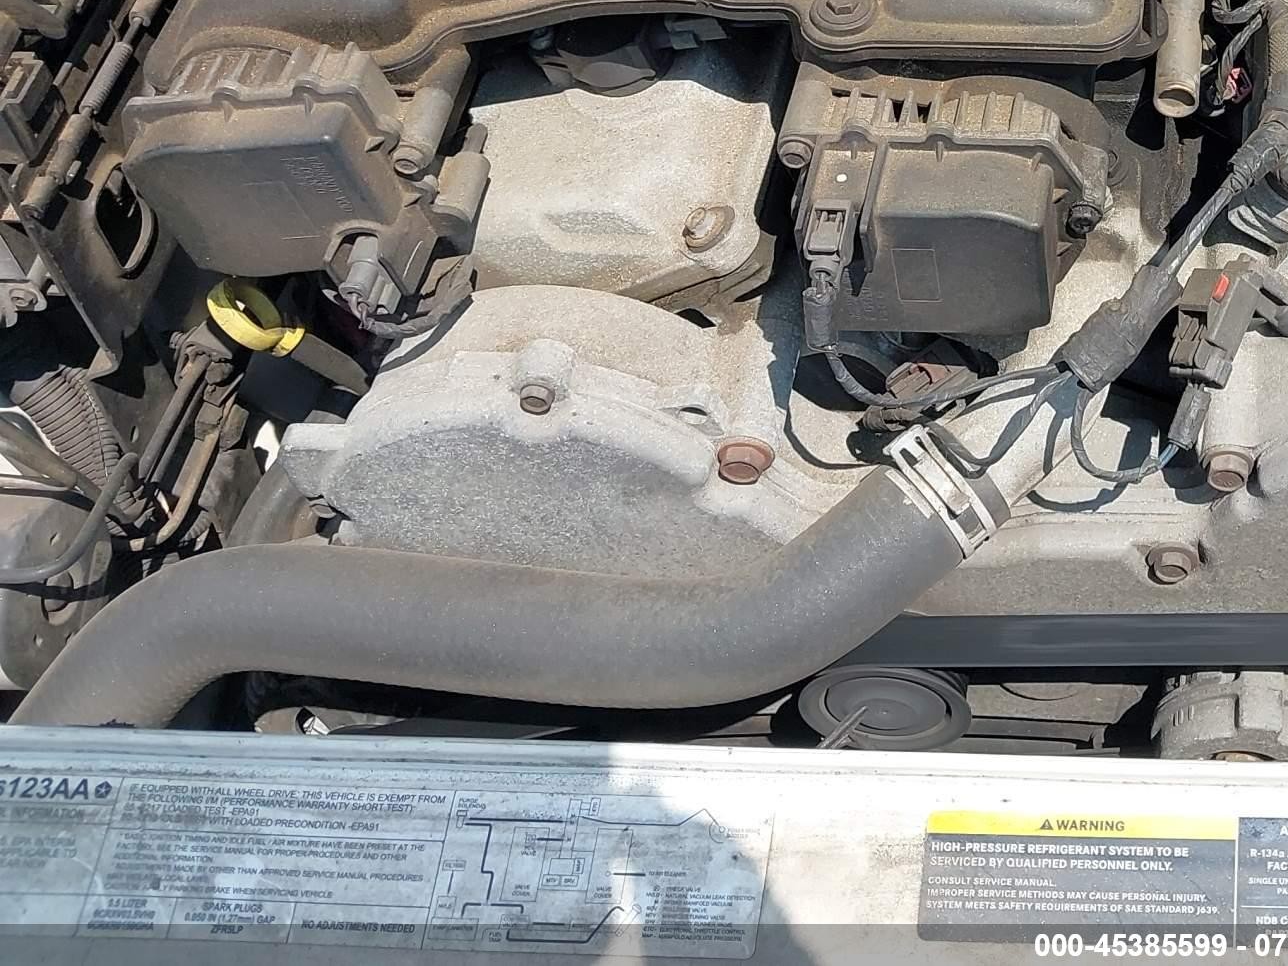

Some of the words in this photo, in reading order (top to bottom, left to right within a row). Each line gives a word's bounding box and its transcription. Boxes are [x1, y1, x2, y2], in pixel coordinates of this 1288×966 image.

[140, 784, 188, 793] EQUIPPED
[191, 786, 214, 795] WITH
[215, 787, 231, 796] ALL
[234, 788, 266, 797] WHEEL
[302, 790, 323, 800] THIS
[325, 792, 363, 801] VEHICLE
[366, 793, 376, 802] IS
[377, 794, 415, 804] EXEMPT
[417, 795, 446, 804] FROM
[127, 793, 145, 802] THE
[149, 794, 203, 804] FOLLOWING
[220, 797, 296, 809] (PERFORMANCE
[297, 801, 349, 811] WARRANTY
[352, 802, 386, 812] SHORT
[203, 806, 226, 815] TEST
[228, 807, 260, 817] -EPA91
[208, 816, 233, 825] WITH
[234, 817, 273, 827] LOADED
[275, 819, 346, 830] PRECONDITION
[348, 822, 379, 832] -EPA91
[1056, 819, 1125, 832] WARNING
[190, 845, 222, 854] SERVICE
[362, 852, 379, 860] AND
[380, 853, 407, 861] OTHER
[321, 841, 342, 849] HAVE
[344, 842, 365, 850] BEEN
[366, 843, 397, 851] PRESET
[410, 844, 425, 852] THE
[931, 841, 1026, 854] HIGH-PRESSURE
[1027, 843, 1106, 856] REFRIGERANT
[1108, 845, 1154, 857] SYSTEM
[1156, 846, 1173, 857] TO
[1174, 847, 1189, 858] BE
[1250, 848, 1285, 859] R-134a
[930, 855, 986, 867] SERVICED
[989, 856, 1005, 868] BY
[1006, 857, 1067, 870] QUALIFIED
[1070, 859, 1139, 871] PERSONNEL
[1140, 860, 1173, 872] ONLY.
[209, 866, 236, 875] OTHER
[237, 867, 257, 875] THAN
[258, 868, 300, 877] APPROVED
[302, 870, 336, 879] SERVICE
[336, 872, 369, 880] MANUAL
[369, 873, 424, 882] PROCEDURES
[928, 876, 971, 886] CONSULT
[973, 877, 1012, 887] SERVICE
[1014, 878, 1057, 887] MANUAL.
[1248, 877, 1278, 885] SINGLE
[204, 886, 231, 895] BRAKE
[927, 888, 975, 898] IMPROPER
[977, 889, 1016, 898] SERVICE
[1018, 890, 1065, 900] METHODS
[1066, 891, 1087, 900] MAY
[1088, 892, 1120, 901] CAUSE
[1121, 892, 1170, 902] PERSONAL
[1172, 893, 1209, 903] INJURY.
[202, 902, 231, 912] SPARK
[233, 904, 263, 914] PLUGS
[926, 900, 963, 910] SYSTEM
[964, 901, 997, 910] MEETS
[998, 901, 1033, 911] SAFETY
[1035, 902, 1108, 912] REQUIREMENTS
[1109, 904, 1123, 913] OF
[1124, 904, 1143, 913] SAE
[1144, 905, 1194, 914] STANDARD
[1195, 906, 1221, 916] J639.
[301, 919, 316, 929] NO
[317, 920, 378, 932] ADJUSTMENTS
[380, 923, 416, 934] NEEDED
